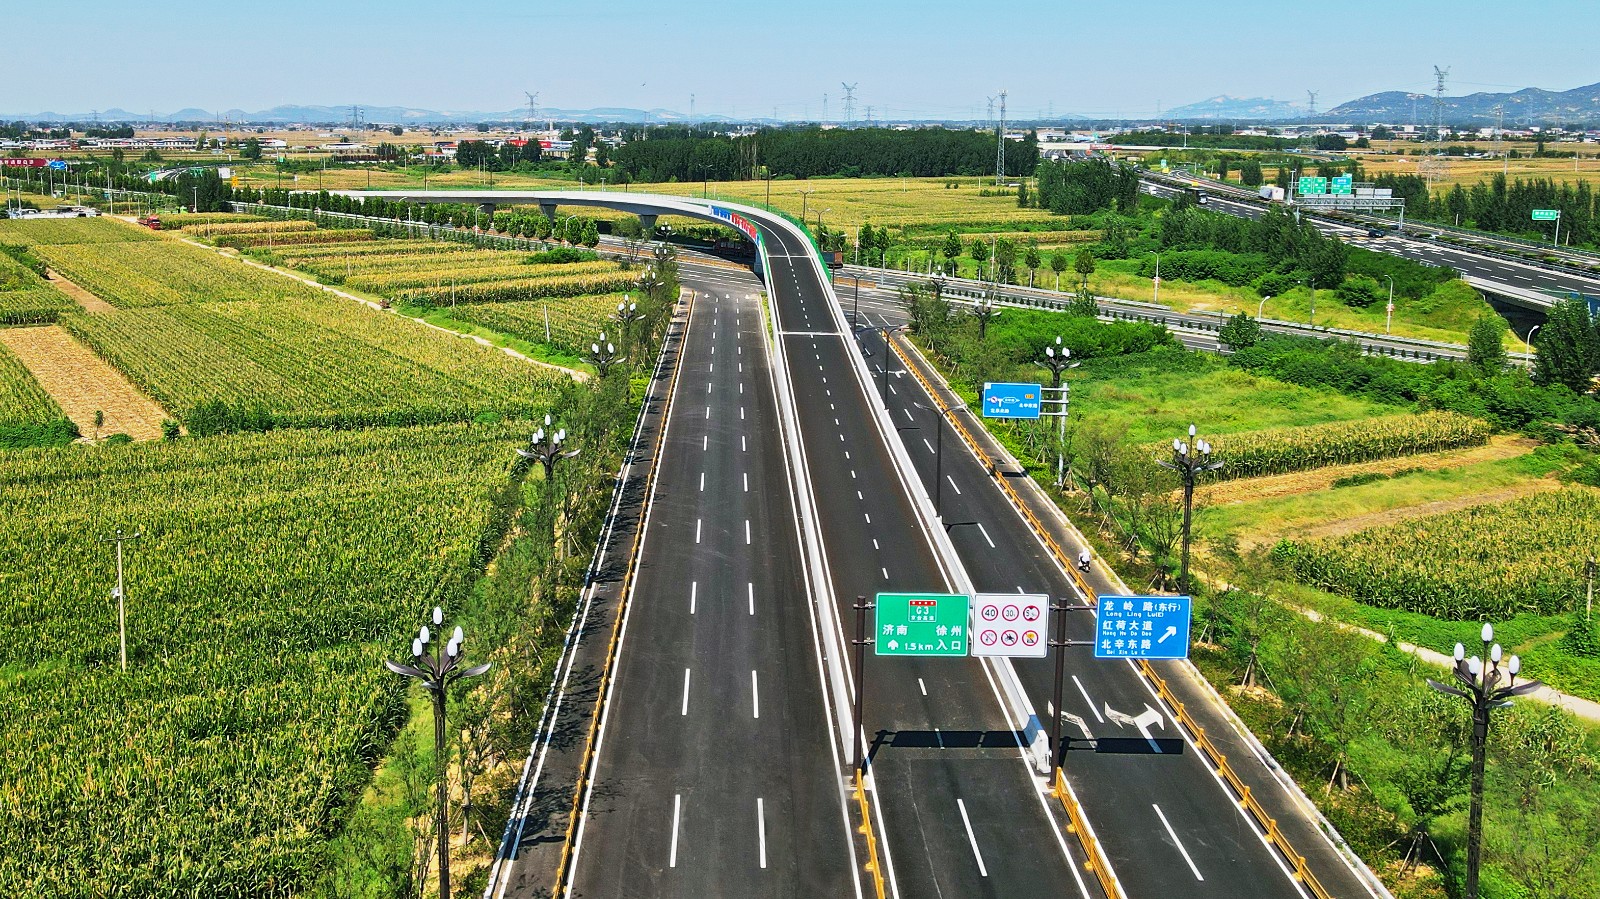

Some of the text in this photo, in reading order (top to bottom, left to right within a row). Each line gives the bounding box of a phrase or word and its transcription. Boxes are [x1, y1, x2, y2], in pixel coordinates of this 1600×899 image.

[915, 606, 930, 615] G3
[984, 609, 996, 617] 40
[882, 624, 962, 637] 济南 徐州
[1102, 619, 1153, 631] 红荷大道
[935, 639, 961, 651] 入口
[1101, 638, 1152, 650] 北辛东路
